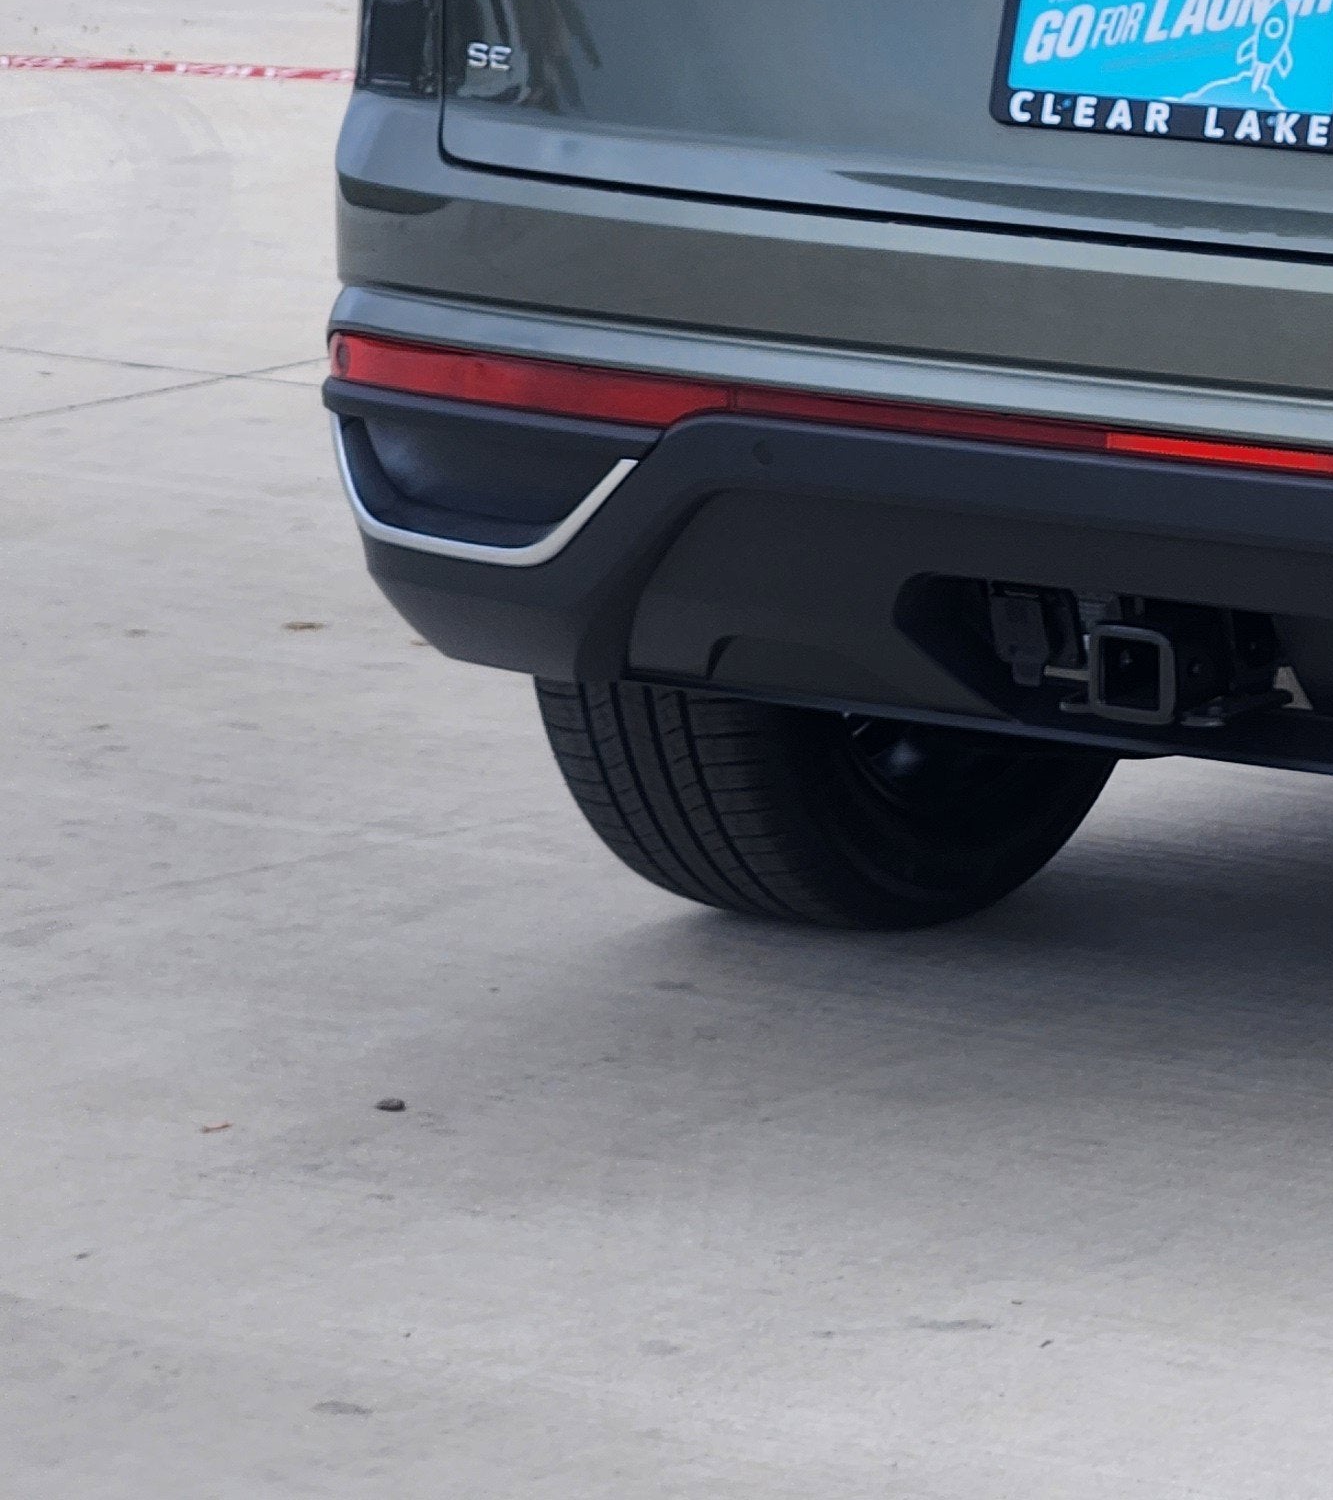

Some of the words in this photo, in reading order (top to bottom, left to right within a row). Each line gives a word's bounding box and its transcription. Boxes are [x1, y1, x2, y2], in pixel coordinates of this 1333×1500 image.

[467, 41, 512, 71] SE
[1023, 3, 1097, 64] GO
[1090, 1, 1146, 50] FOR
[1009, 89, 1171, 134] CLEAR
[1203, 106, 1332, 147] LAKE
